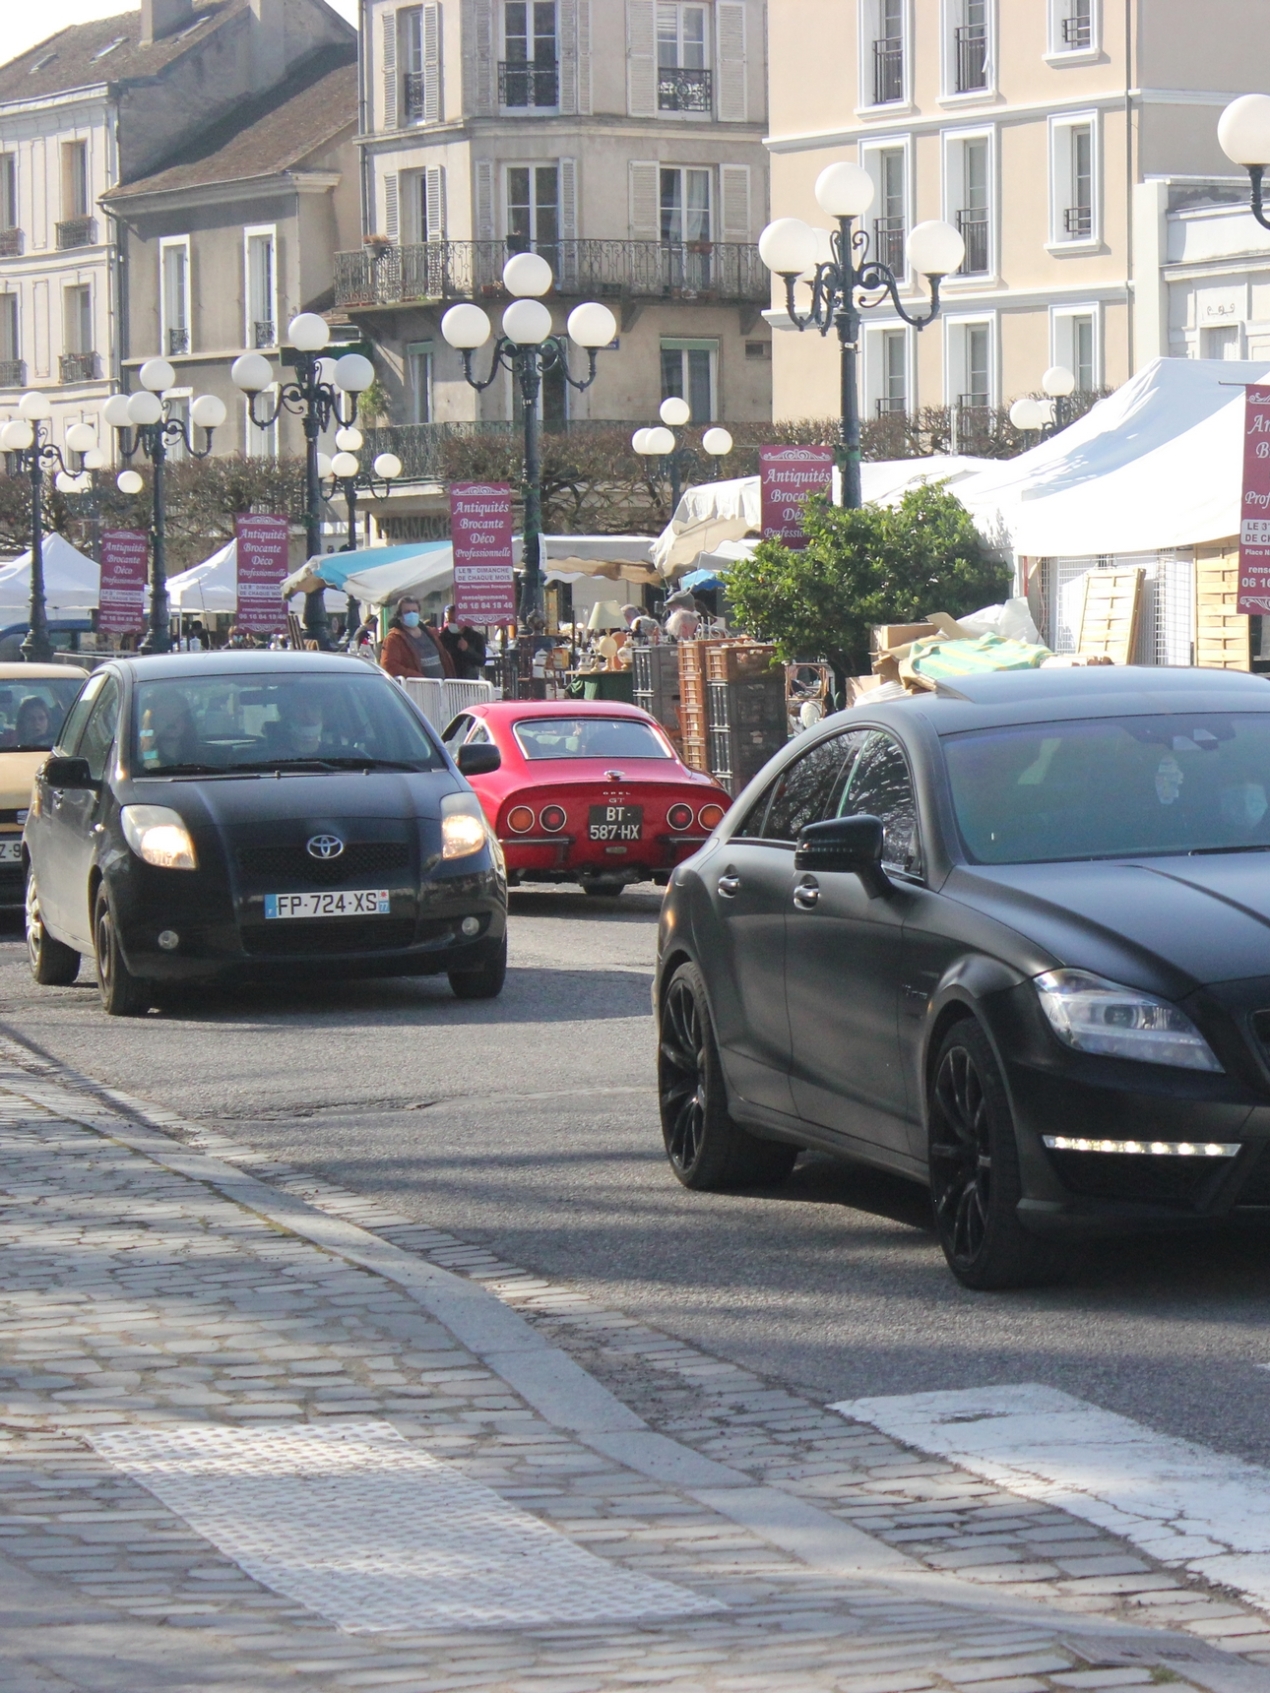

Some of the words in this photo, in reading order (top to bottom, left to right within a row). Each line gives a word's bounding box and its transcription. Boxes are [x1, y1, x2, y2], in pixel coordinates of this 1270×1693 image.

[763, 468, 831, 487] Antiquités
[453, 501, 509, 516] Antiquités
[460, 518, 504, 529] Brocante
[1247, 522, 1259, 531] LE
[239, 528, 286, 542] Antiquités
[470, 532, 495, 544] Déco
[1245, 534, 1258, 542] DE
[103, 542, 146, 554] Antiquités
[243, 542, 281, 553] Brocante
[107, 554, 140, 564] Brocante
[455, 547, 511, 560] Professionnelle
[251, 555, 273, 565] Déco
[113, 565, 133, 575] Déco
[1241, 577, 1256, 587] 06
[590, 825, 640, 840] 587-HX
[278, 892, 377, 915] FP-724-XS
